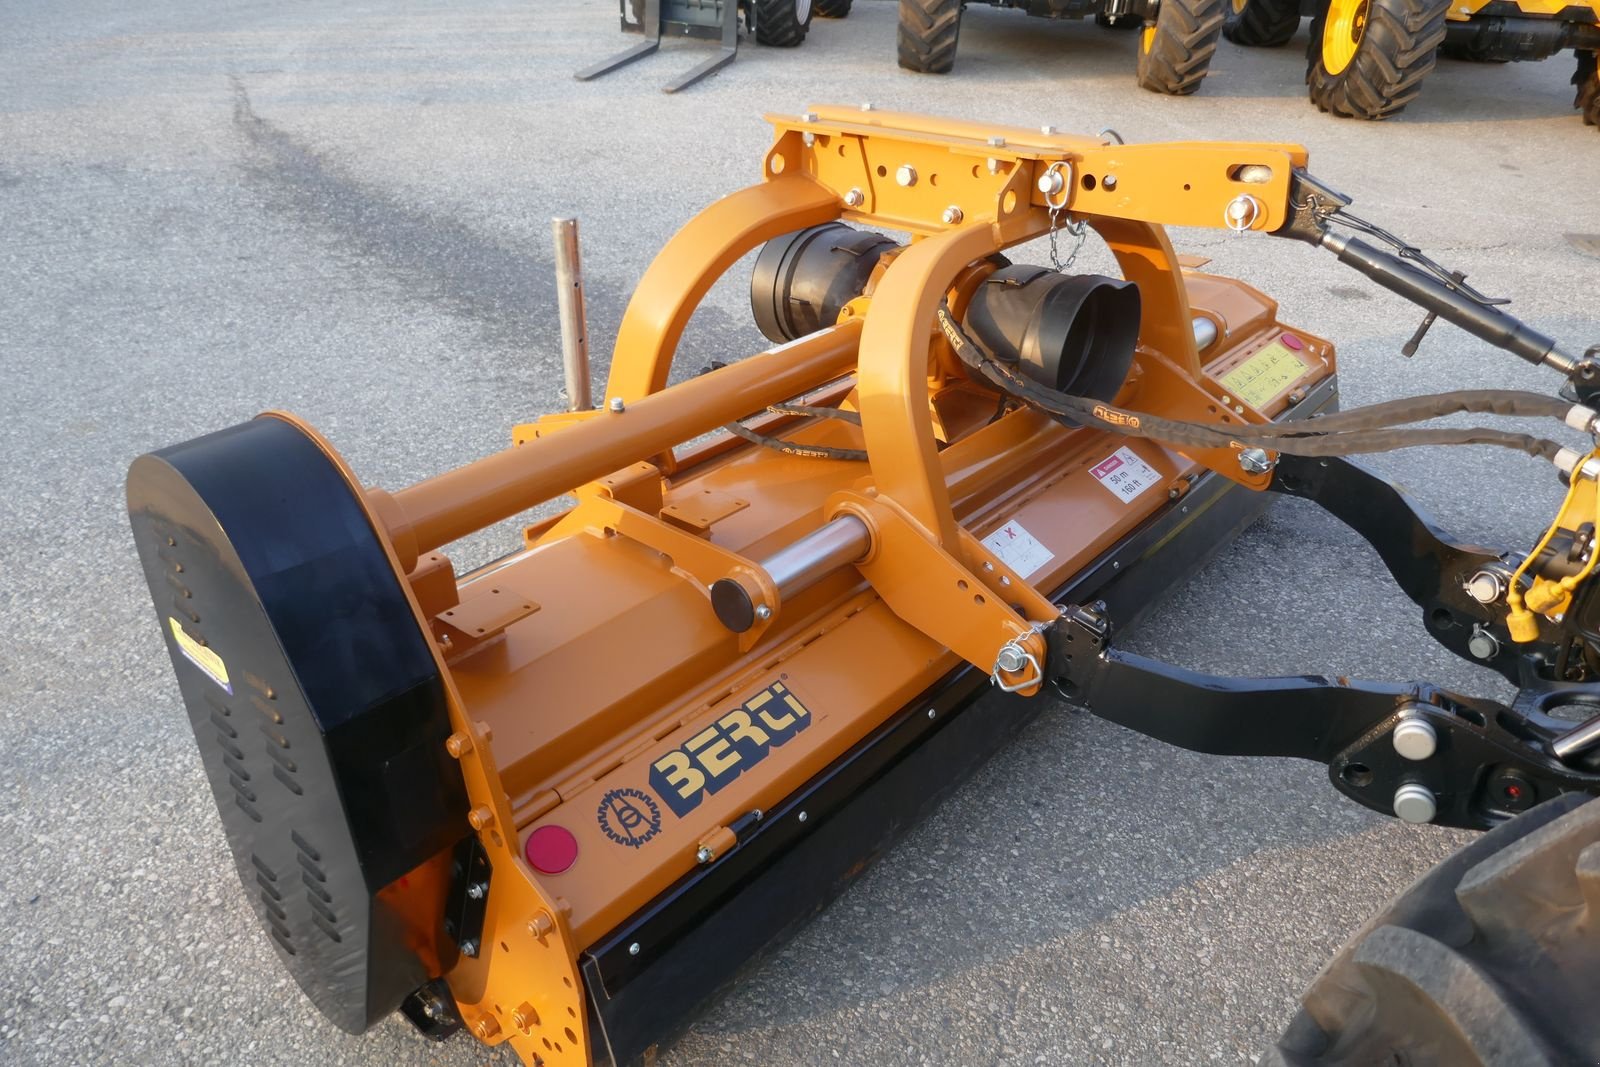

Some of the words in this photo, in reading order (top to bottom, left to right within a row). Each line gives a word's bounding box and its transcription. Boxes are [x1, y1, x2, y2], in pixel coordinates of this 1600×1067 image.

[1110, 474, 1122, 485] 50
[1120, 471, 1129, 479] m
[1121, 483, 1137, 496] 160
[1133, 479, 1142, 488] ft
